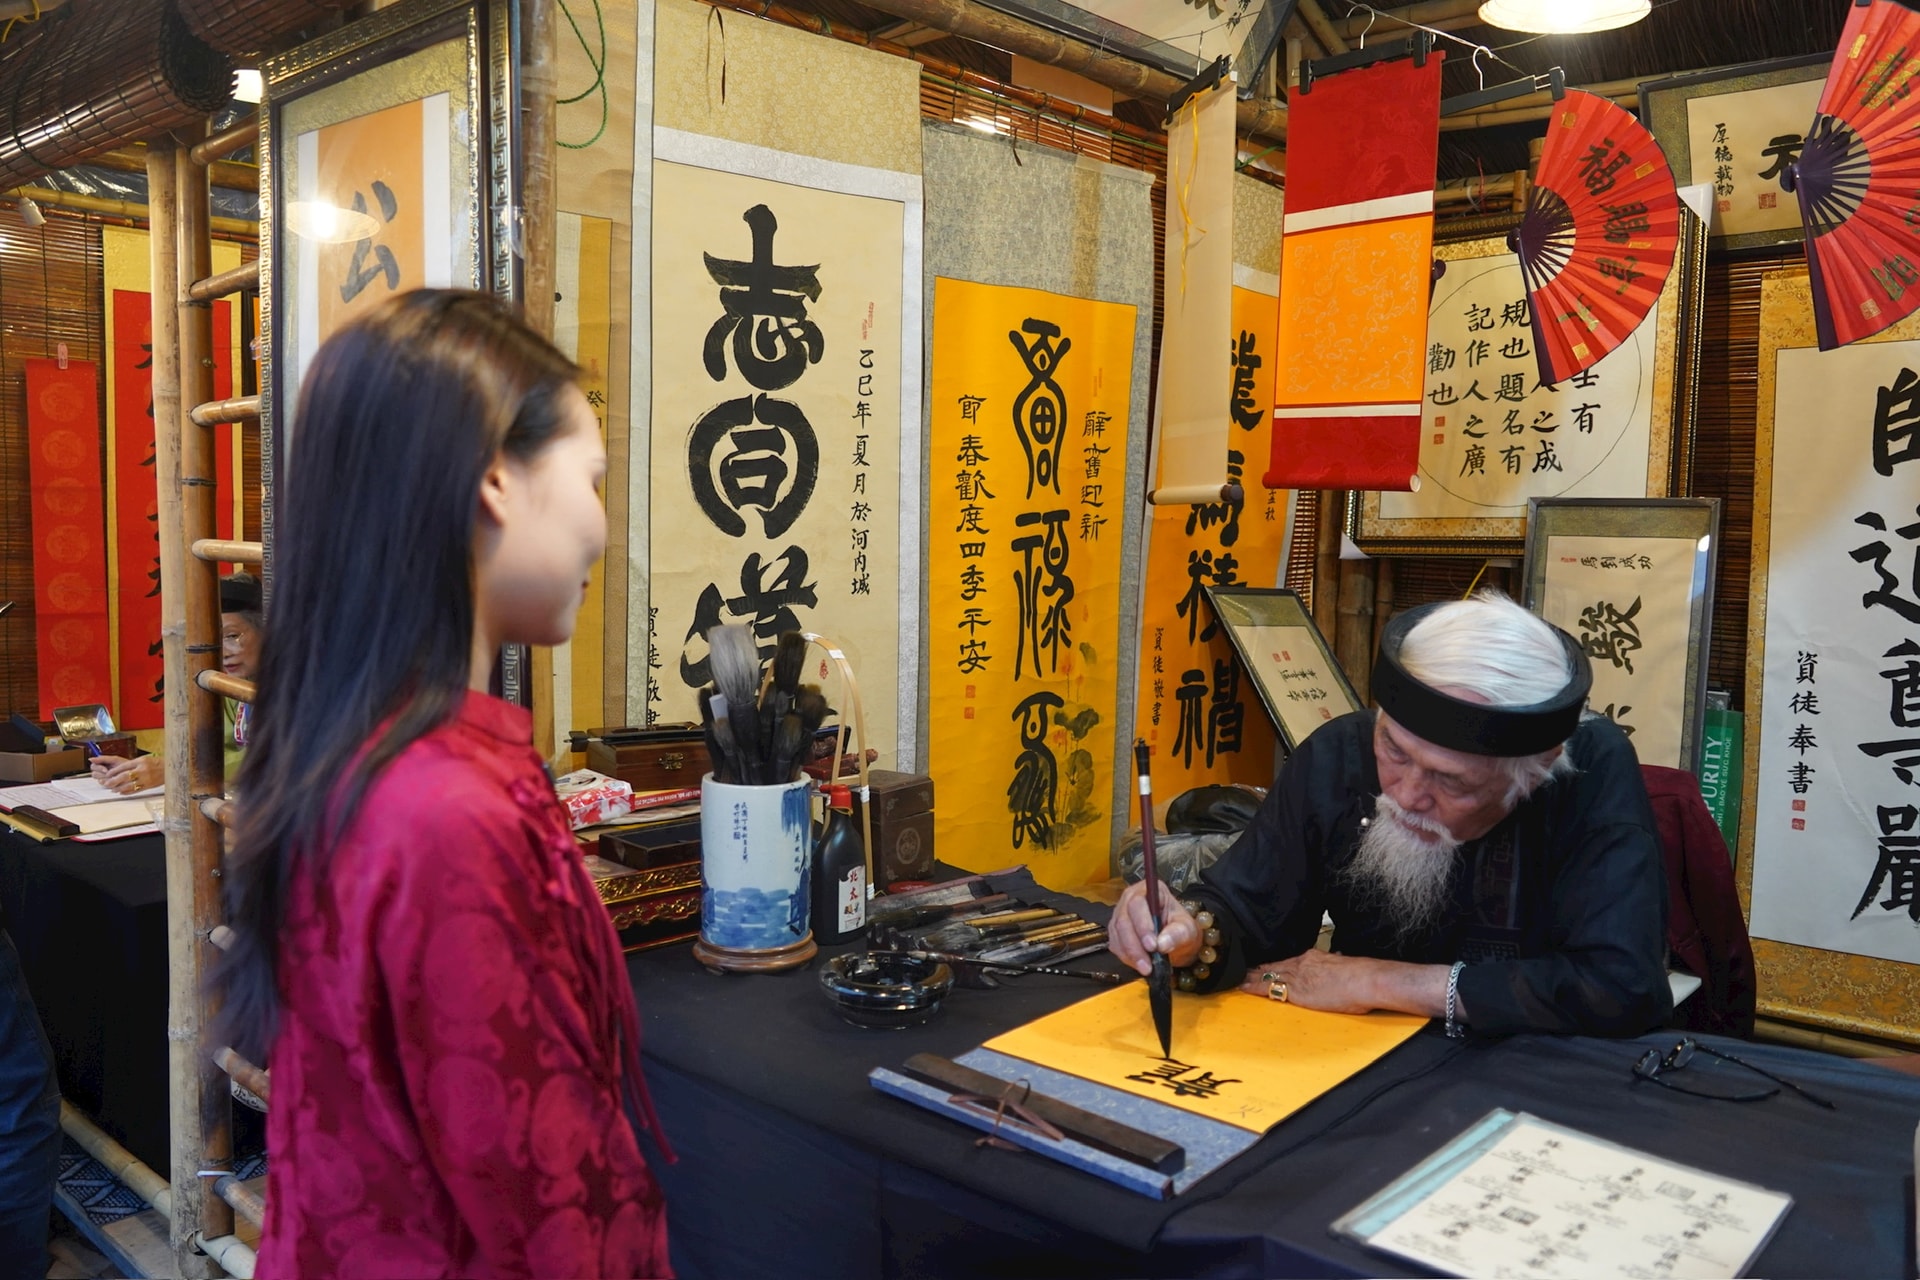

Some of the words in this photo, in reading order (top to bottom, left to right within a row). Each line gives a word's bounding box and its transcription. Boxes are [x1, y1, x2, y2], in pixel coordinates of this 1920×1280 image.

[1427, 342, 1459, 406] 勸也
[1459, 303, 1495, 478] 記作人之廣
[1080, 411, 1112, 542] 辭舊迎新
[1786, 651, 1821, 794] 資徒奉書
